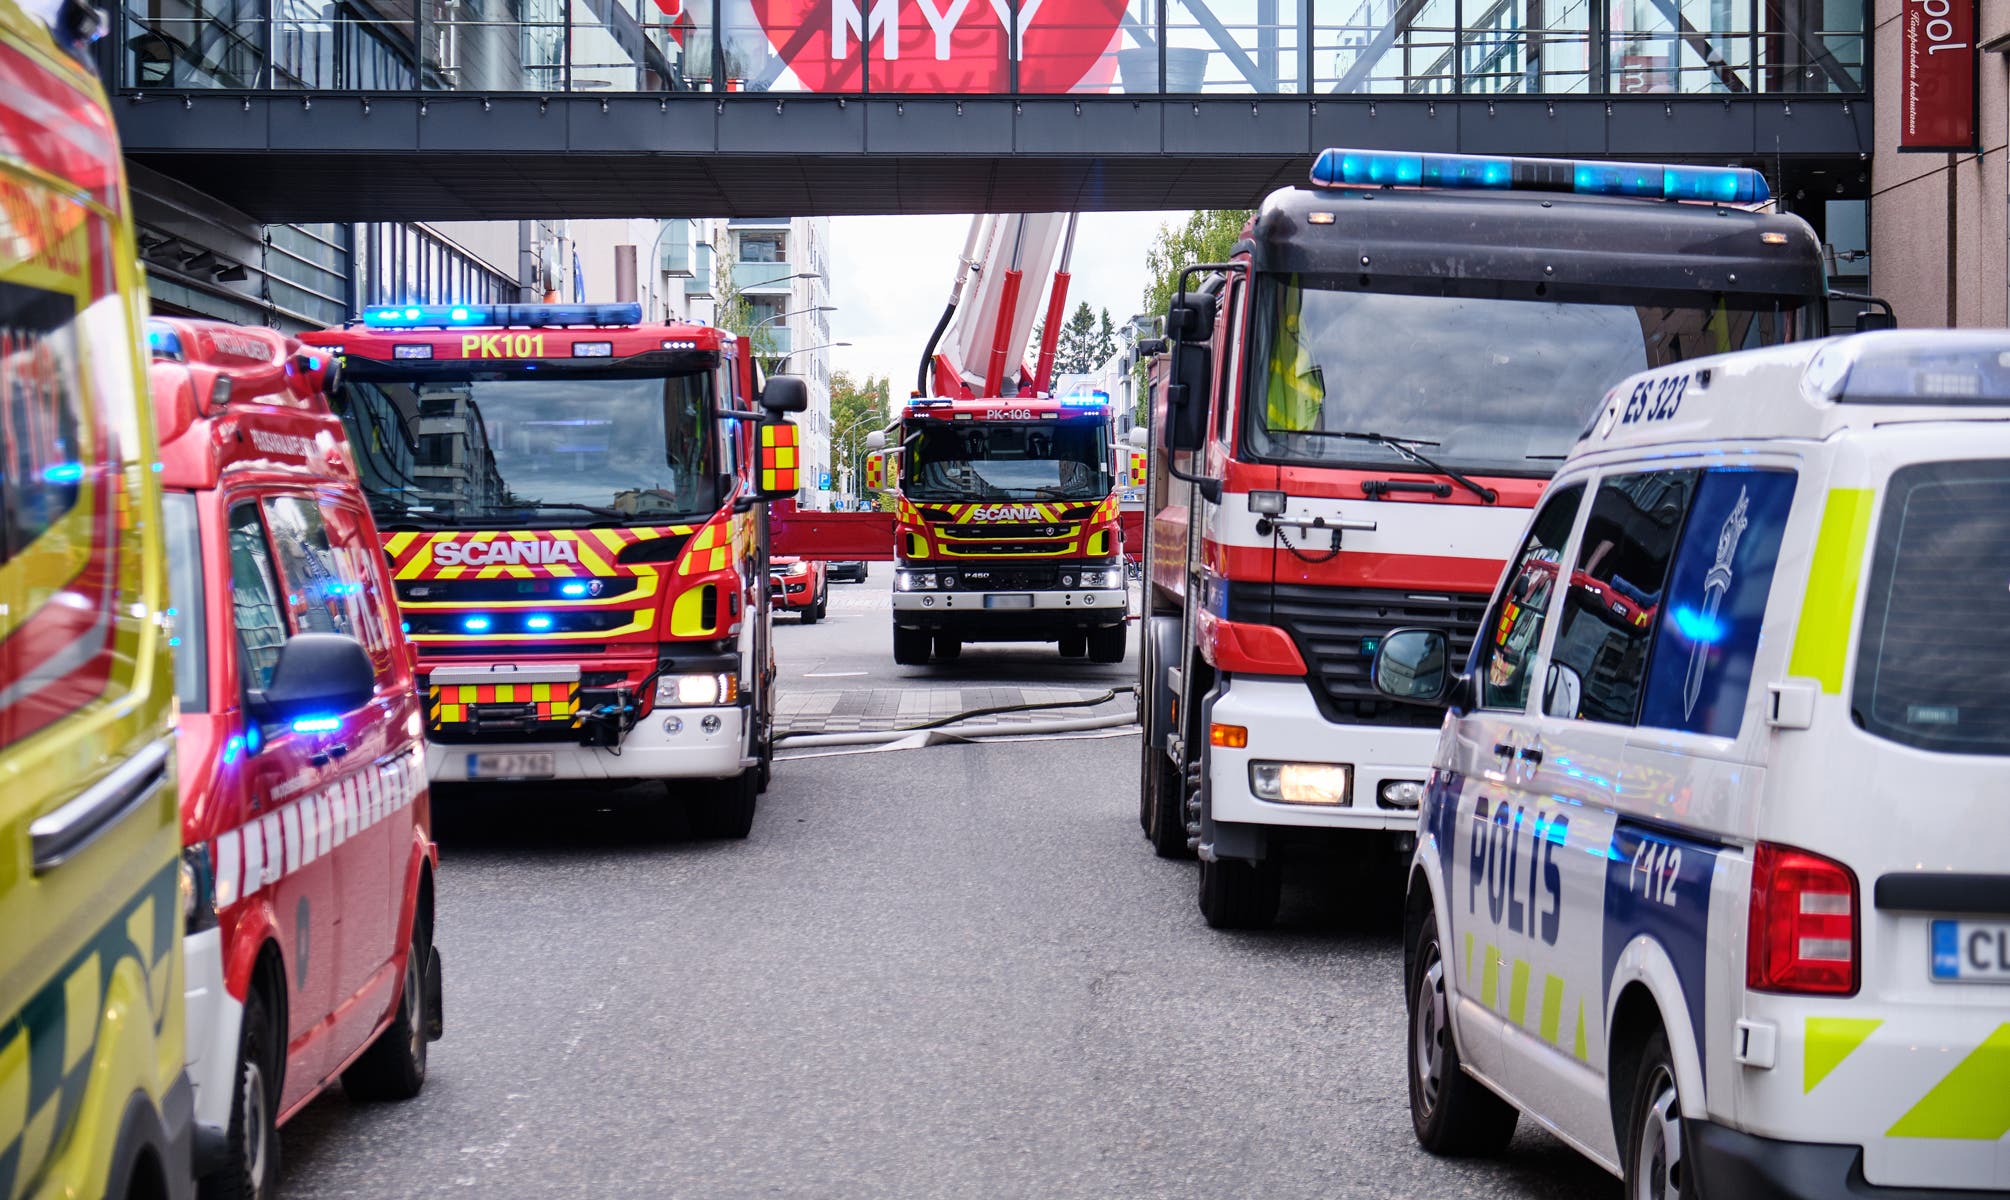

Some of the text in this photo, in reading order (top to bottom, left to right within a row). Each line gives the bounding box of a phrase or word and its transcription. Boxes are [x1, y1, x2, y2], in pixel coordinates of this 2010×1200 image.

[831, 0, 1044, 61] MYY
[1907, 9, 1920, 135] Kauppakeskus keskustassa
[462, 334, 544, 358] PK101
[986, 409, 1031, 420] PK-106
[1622, 374, 1690, 424] ES 323
[973, 507, 1041, 521] SCANIA
[433, 540, 577, 566] SCANIA
[1469, 796, 1569, 947] POLIS
